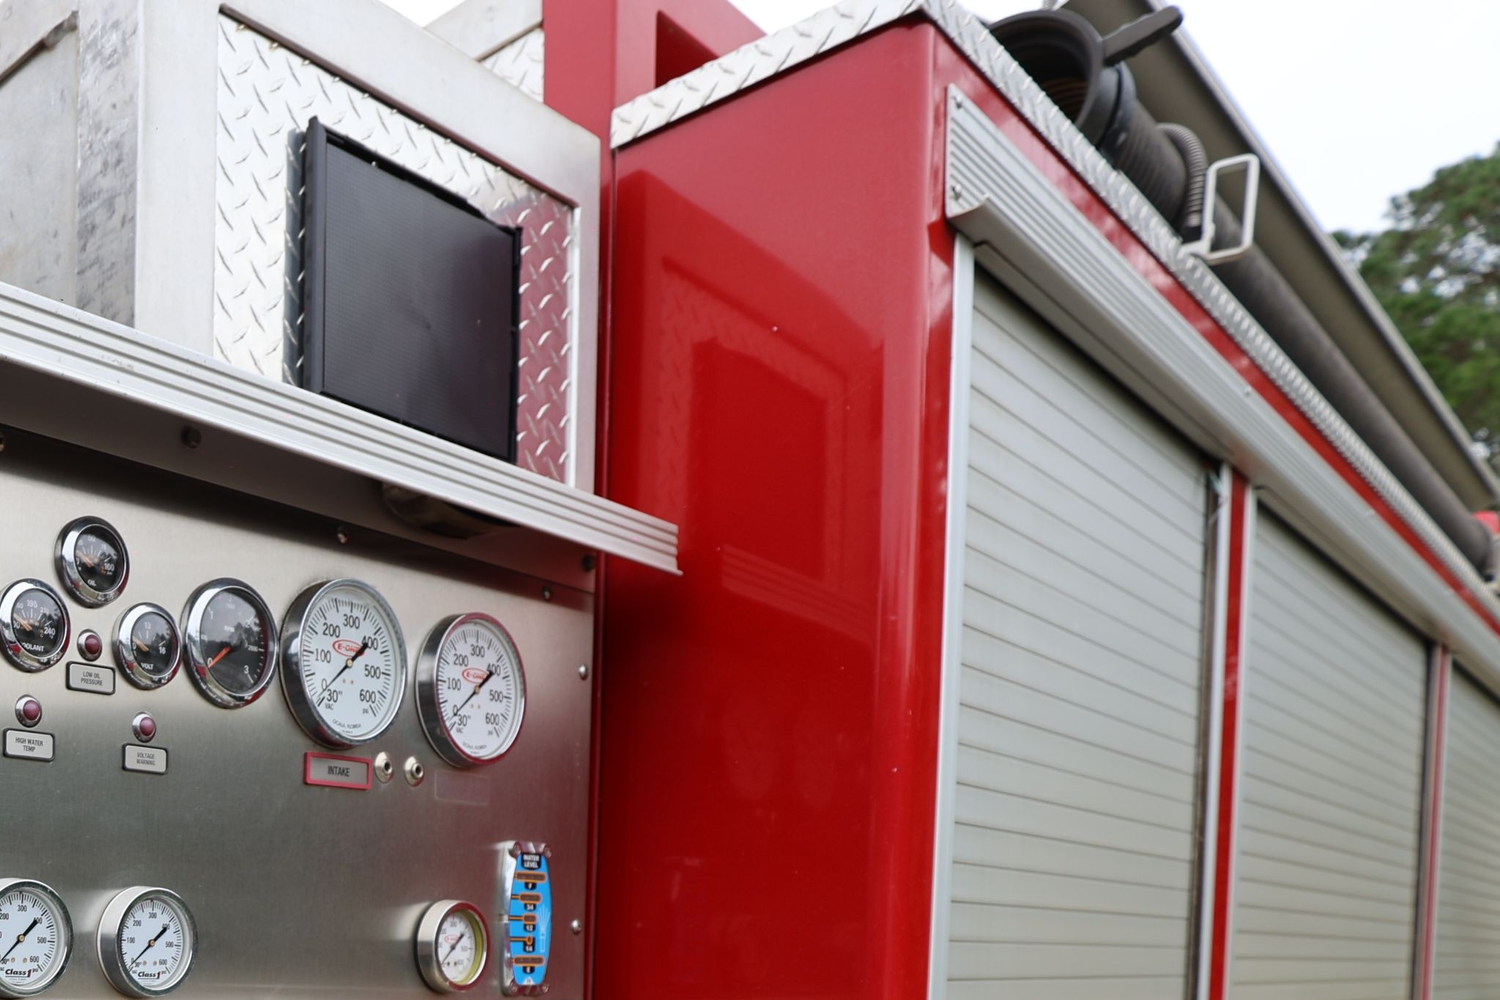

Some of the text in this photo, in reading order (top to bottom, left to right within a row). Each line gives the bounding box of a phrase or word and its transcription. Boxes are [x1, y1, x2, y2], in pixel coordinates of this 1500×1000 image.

[27, 600, 38, 608] 195
[343, 614, 360, 630] 300
[323, 623, 341, 638] 200
[315, 649, 331, 664] 100
[471, 644, 485, 658] 300
[454, 653, 469, 667] 200
[244, 665, 250, 674] 3
[365, 665, 381, 679] 500
[81, 678, 103, 687] PRESSURE
[447, 678, 461, 691] 100
[360, 689, 376, 704] 600
[490, 690, 503, 703] 500
[486, 713, 500, 726] 600
[15, 737, 44, 747] HIGH WATER
[137, 752, 155, 760] VOLTAGE
[328, 765, 351, 778] INTAKE
[524, 860, 539, 869] LEVEL
